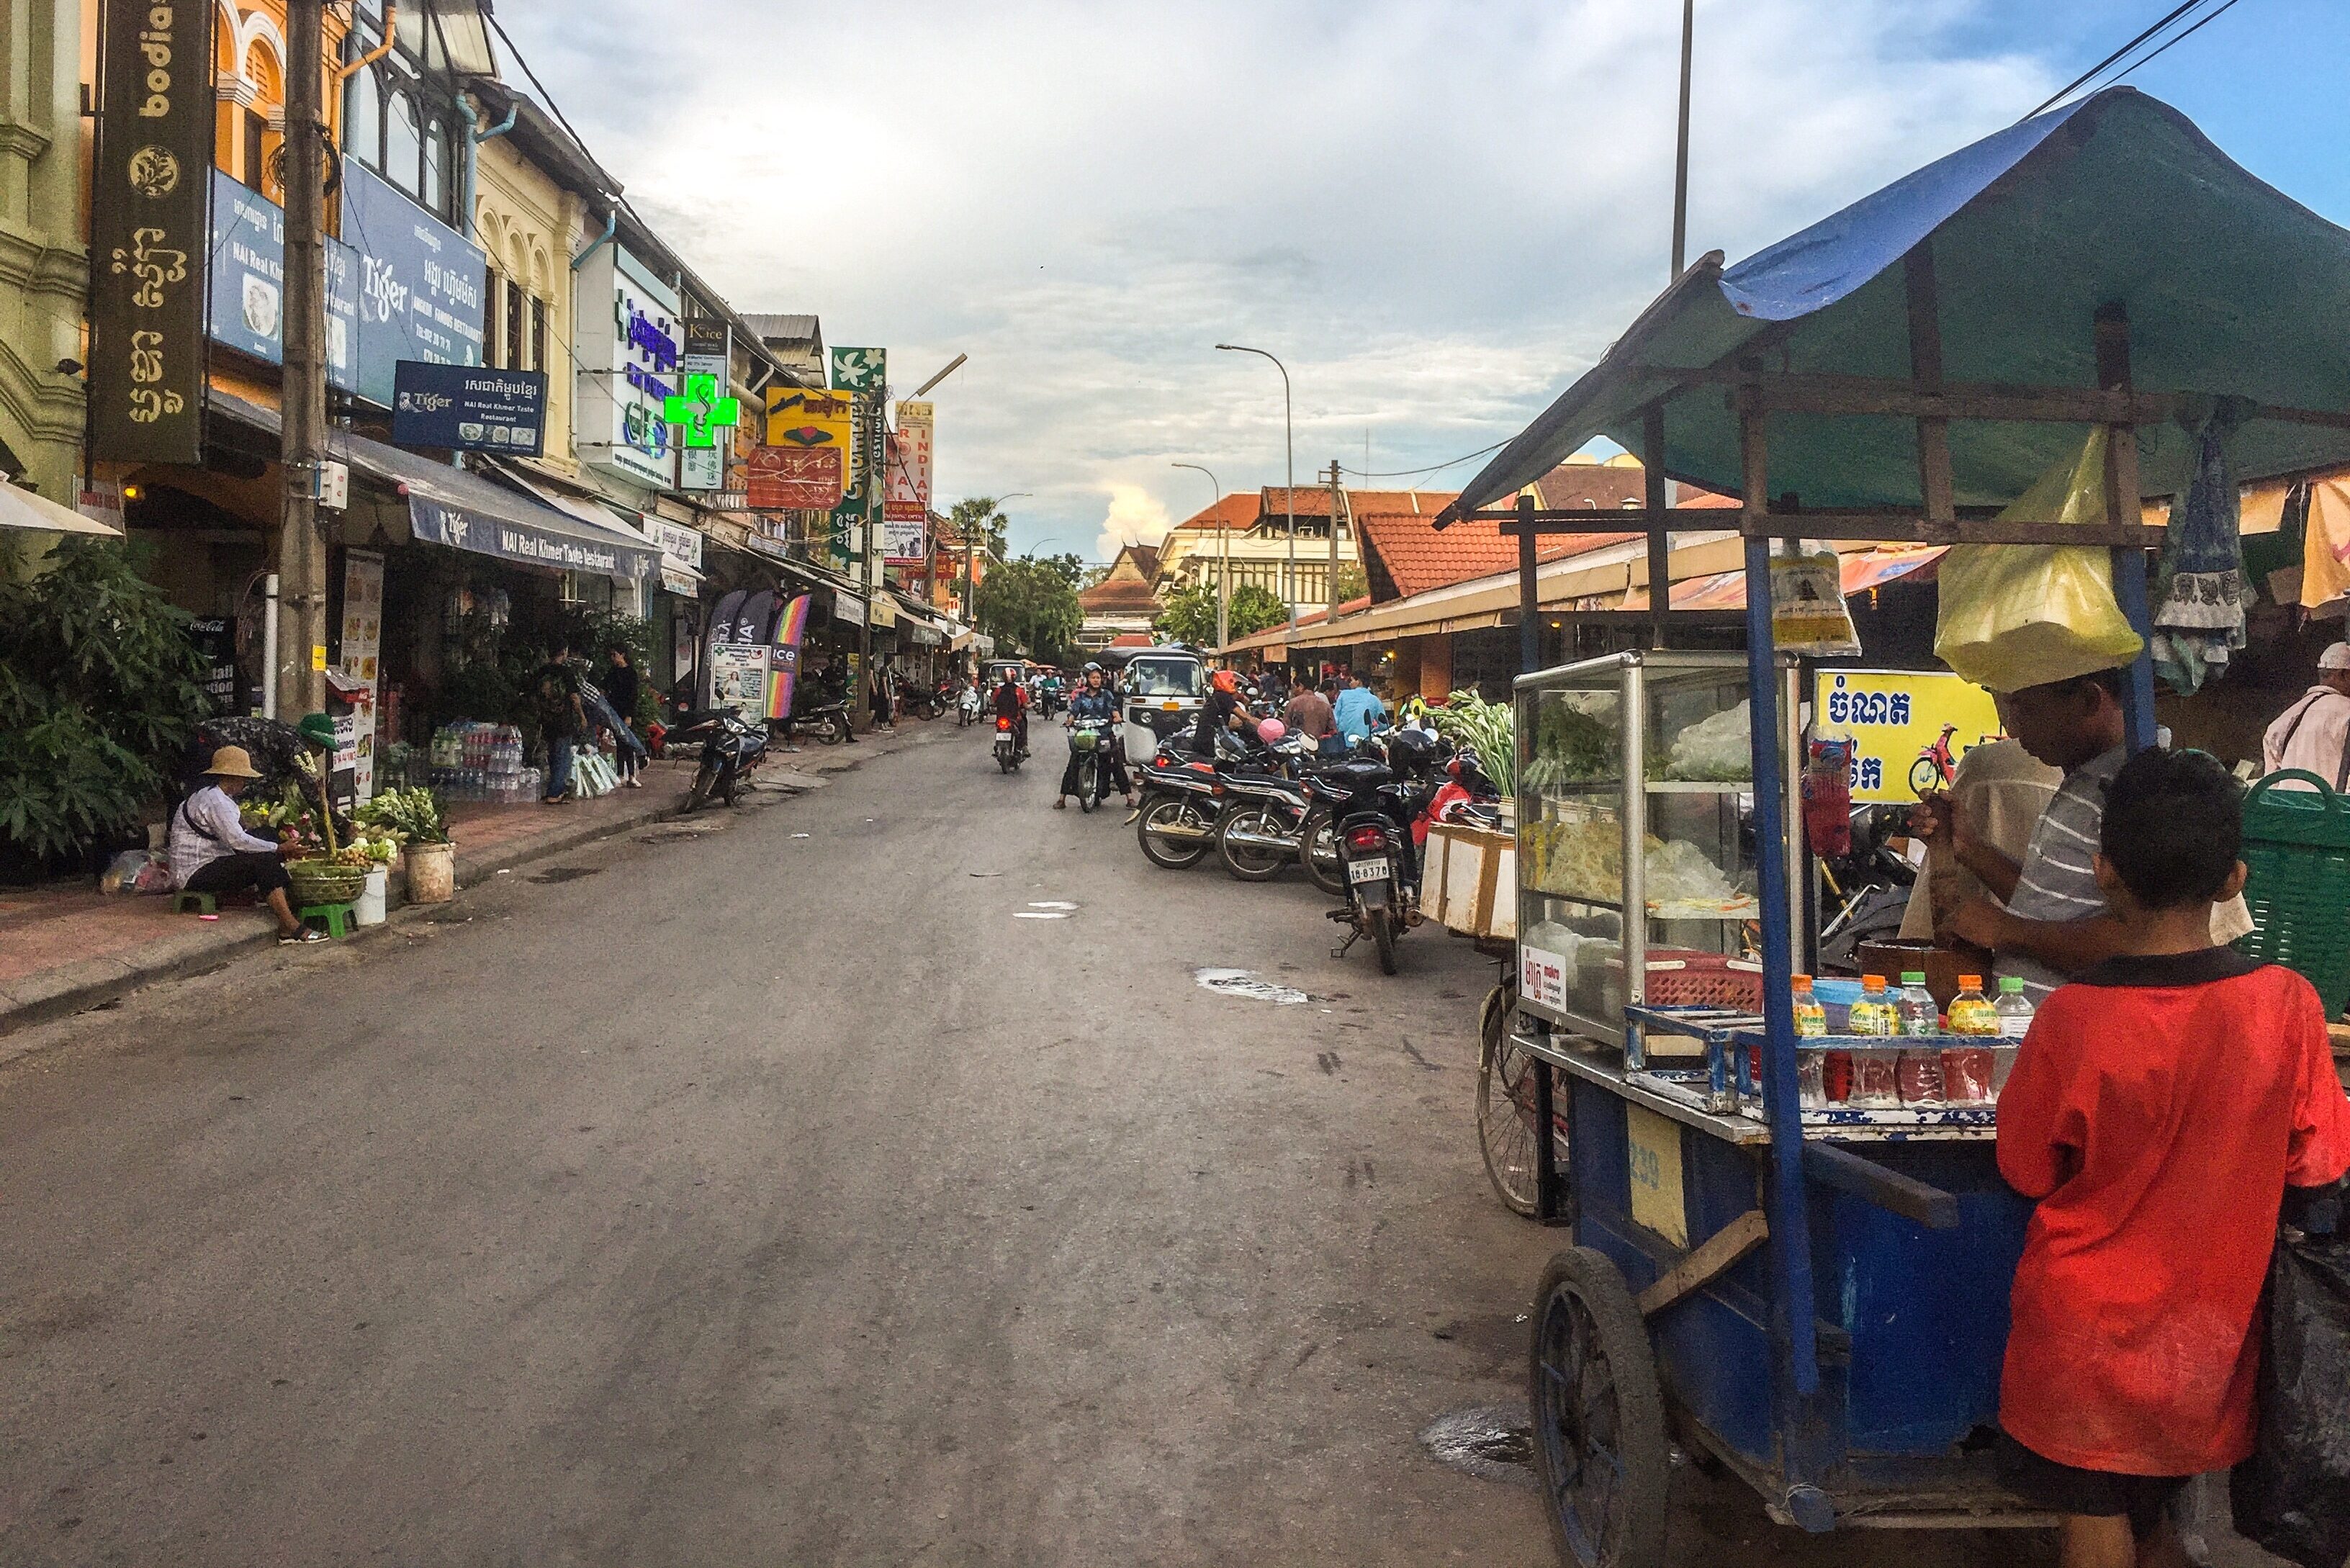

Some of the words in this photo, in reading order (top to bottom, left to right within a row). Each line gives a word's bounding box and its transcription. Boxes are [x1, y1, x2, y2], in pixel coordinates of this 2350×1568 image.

[362, 253, 408, 323] Tiger
[414, 392, 454, 412] Tiger
[480, 413, 517, 423] Restaurant
[517, 405, 534, 413] Taste
[917, 429, 929, 501] INDIAN
[448, 512, 468, 545] Tiger
[502, 530, 517, 552] NAI
[518, 534, 537, 557] Real
[539, 538, 564, 562] Khmer
[1829, 675, 1910, 724] ចំណត
